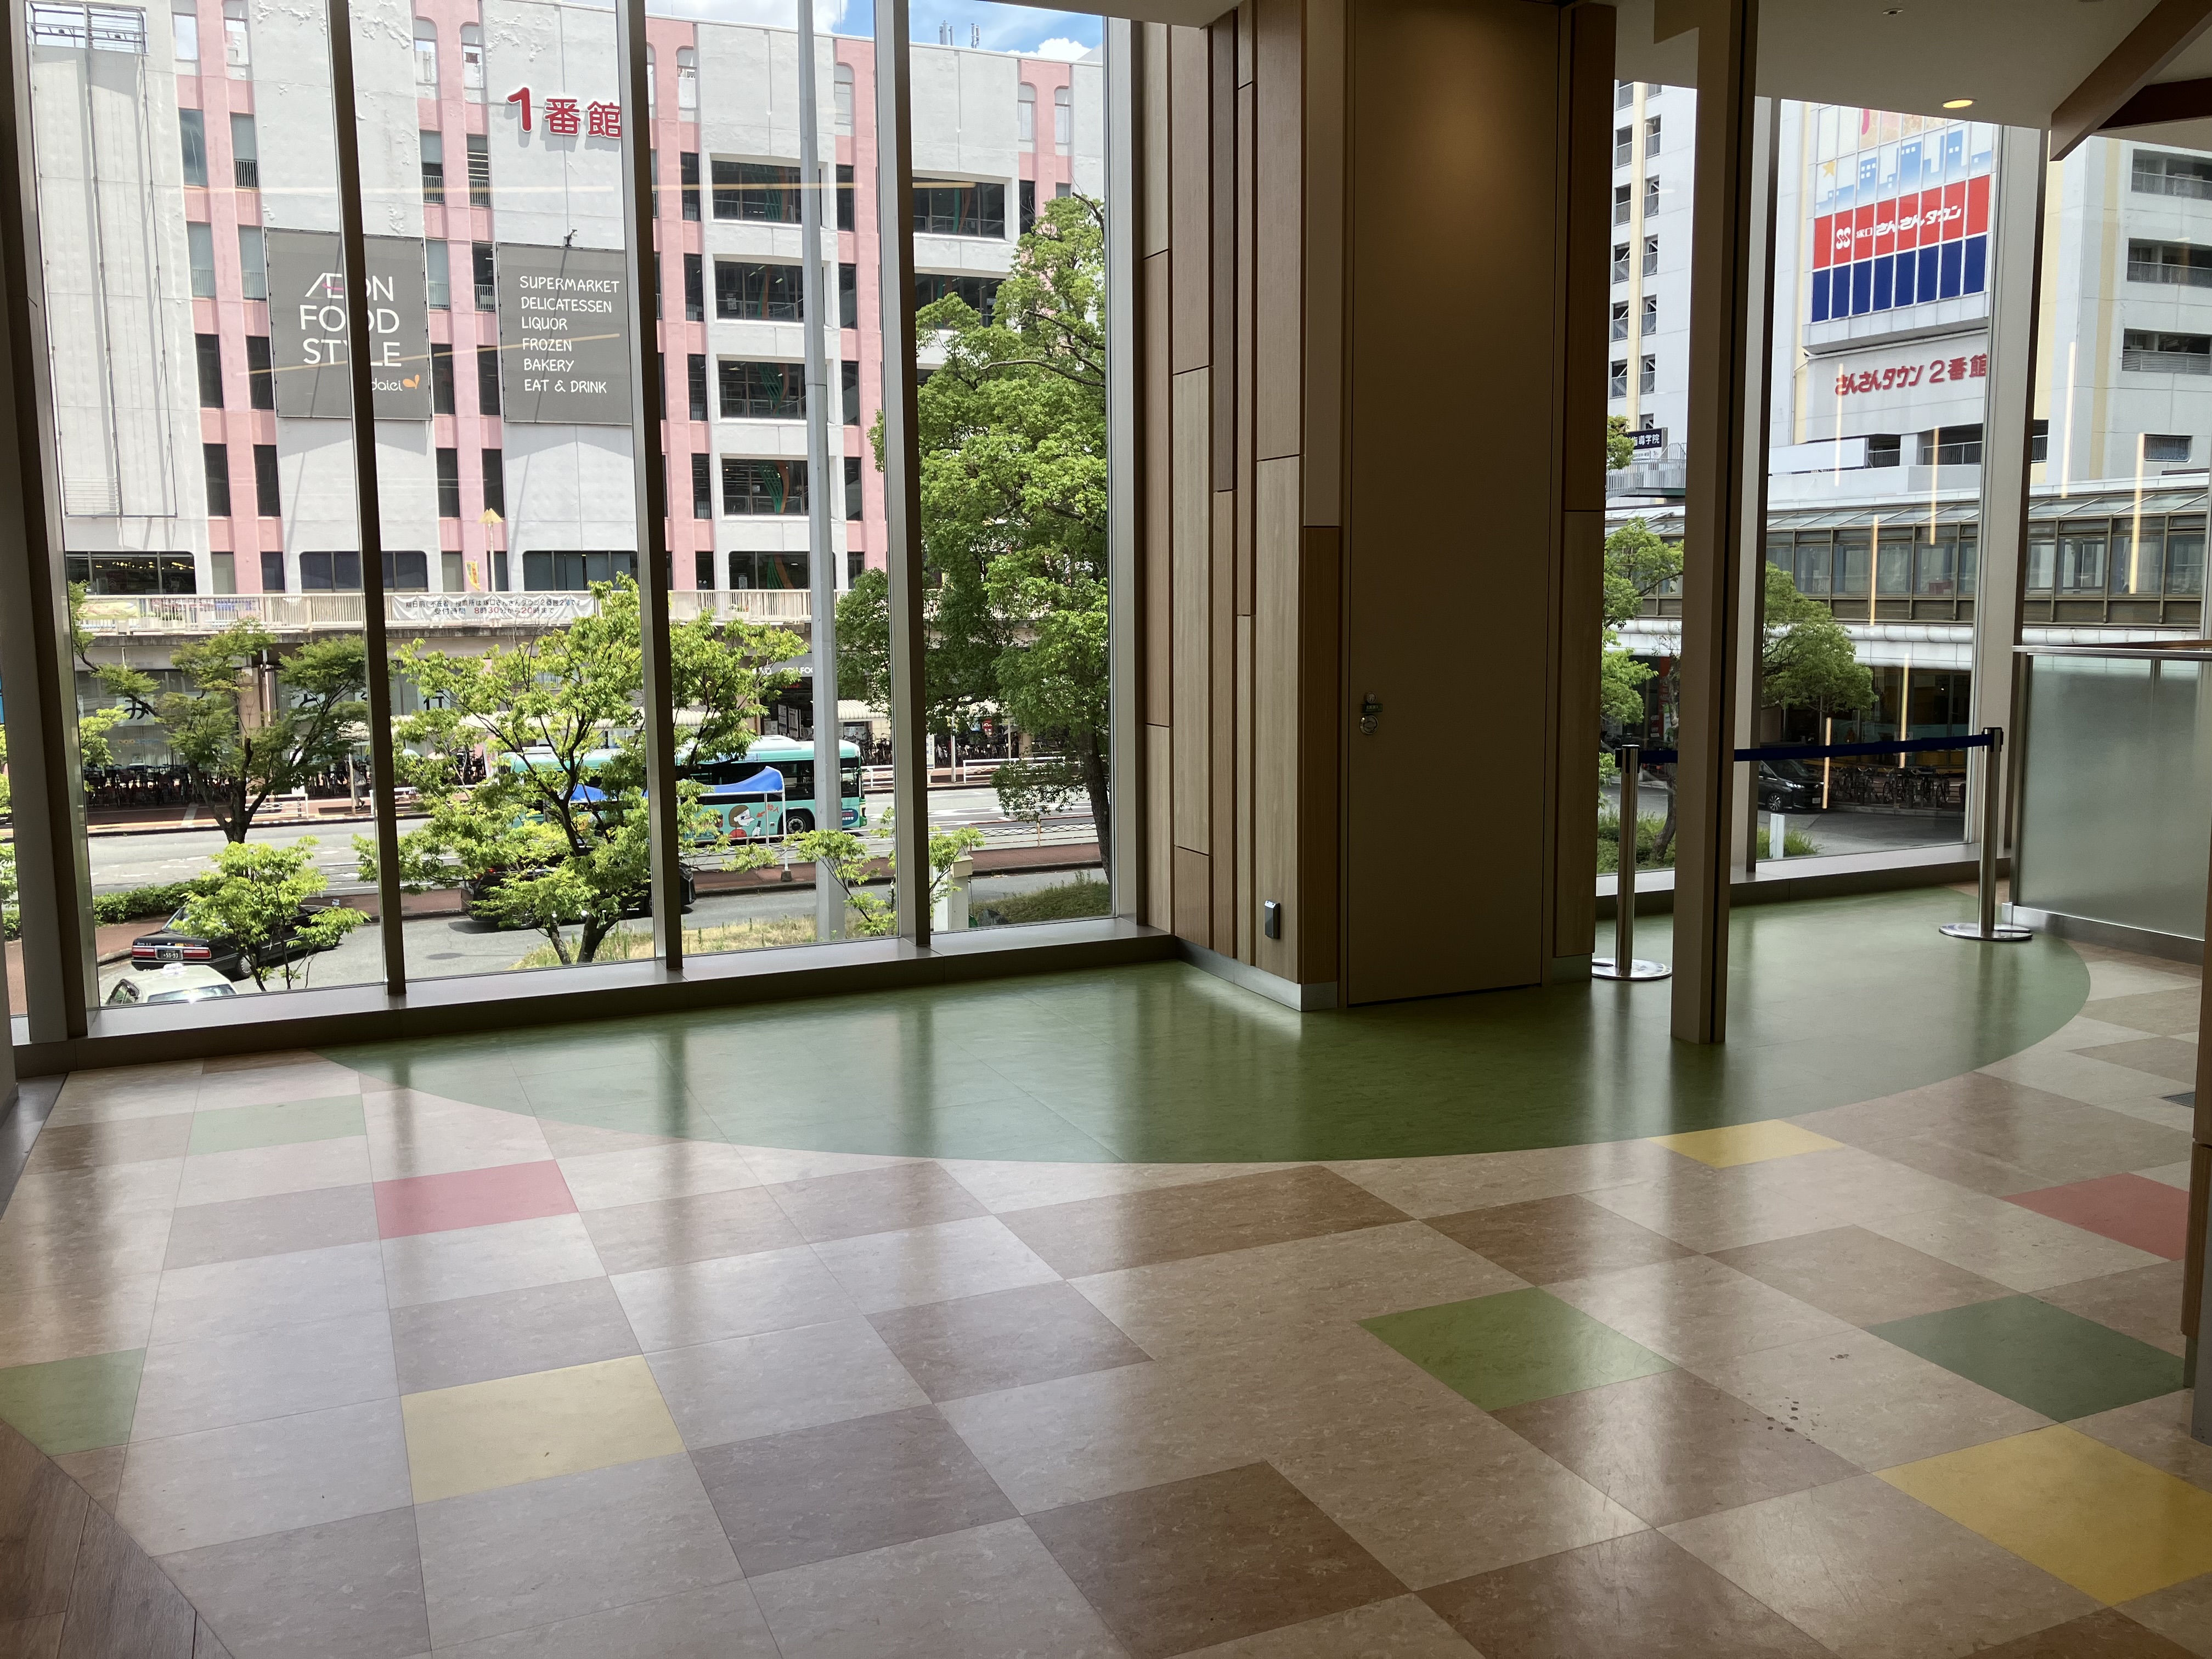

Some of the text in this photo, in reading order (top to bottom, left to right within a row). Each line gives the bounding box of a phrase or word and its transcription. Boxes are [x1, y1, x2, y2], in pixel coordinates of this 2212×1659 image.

[507, 87, 621, 138] 1番館
[520, 276, 619, 293] SUPERMARKET
[521, 297, 612, 313] DELICATESSEN
[522, 317, 568, 330] LIQUOR
[522, 338, 572, 352] FROZEN
[523, 358, 574, 372] BAKERY
[524, 379, 607, 393] EAT & DRINK
